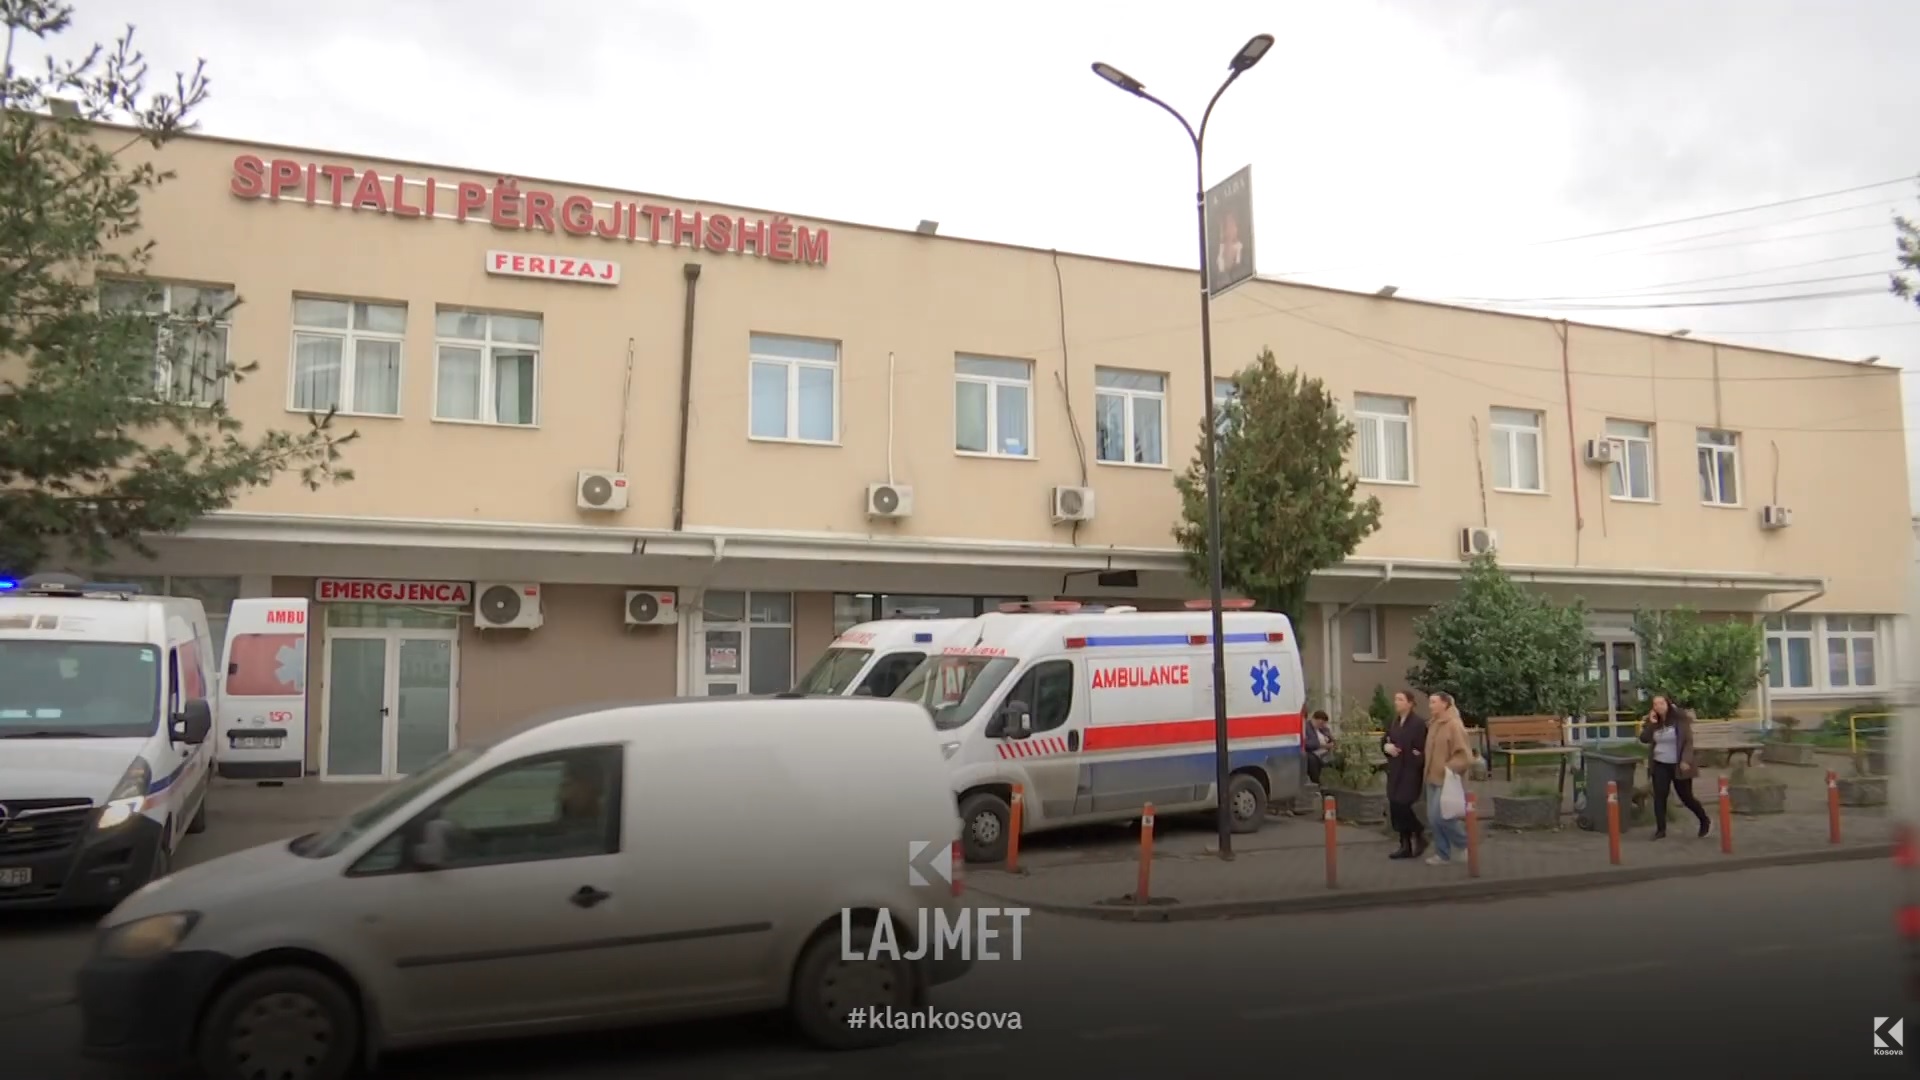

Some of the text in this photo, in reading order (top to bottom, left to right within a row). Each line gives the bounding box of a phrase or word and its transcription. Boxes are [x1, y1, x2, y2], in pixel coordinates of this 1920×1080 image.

[231, 155, 830, 267] SPITALI PËRGJITHSHËM
[495, 253, 613, 279] FERIZAJ
[320, 581, 467, 602] EMERGJENCA
[266, 610, 305, 624] AMBU
[1091, 664, 1190, 689] AMBULANCE
